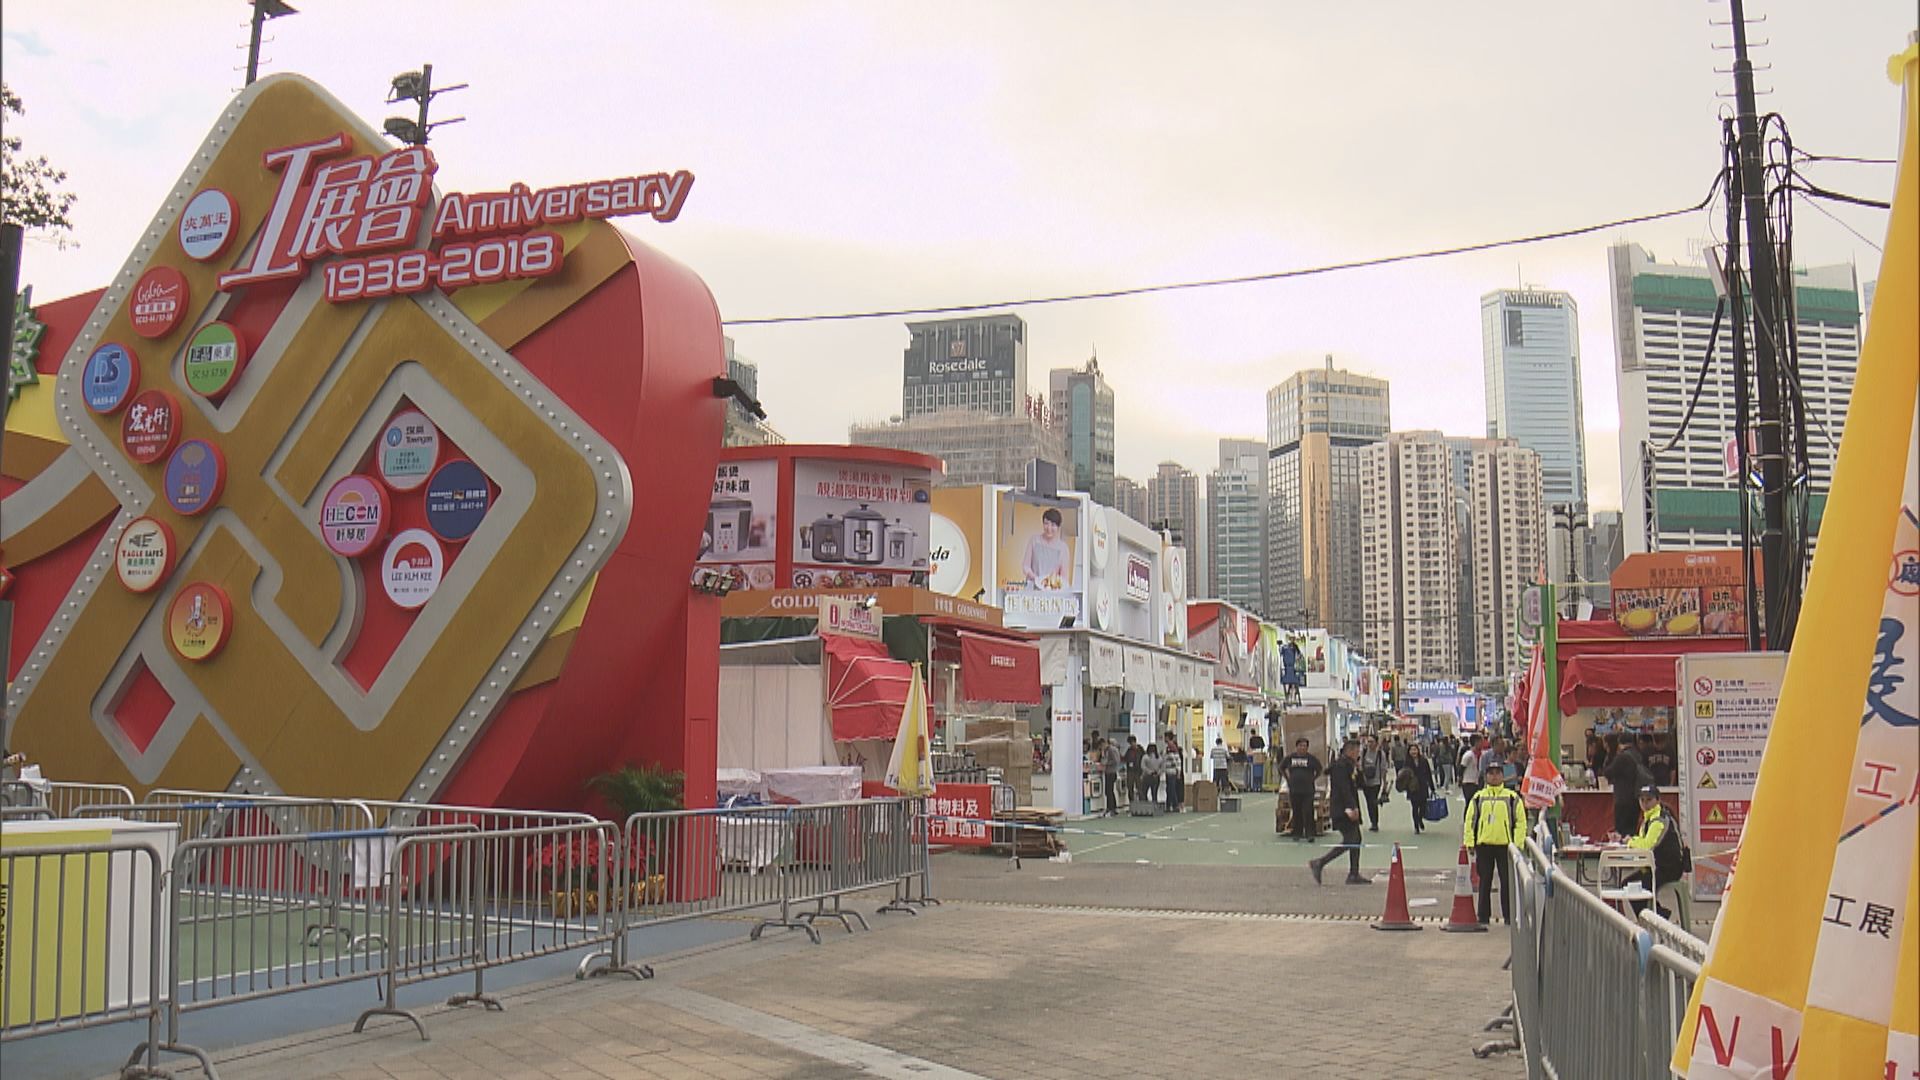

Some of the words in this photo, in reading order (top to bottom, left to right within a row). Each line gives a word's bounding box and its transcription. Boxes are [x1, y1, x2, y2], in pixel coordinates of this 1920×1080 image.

[217, 138, 428, 288] 工展會
[435, 172, 687, 234] Anniversary
[326, 235, 554, 299] 1938-2018
[929, 358, 986, 373] Rosedale
[1407, 681, 1454, 690] GERMAN
